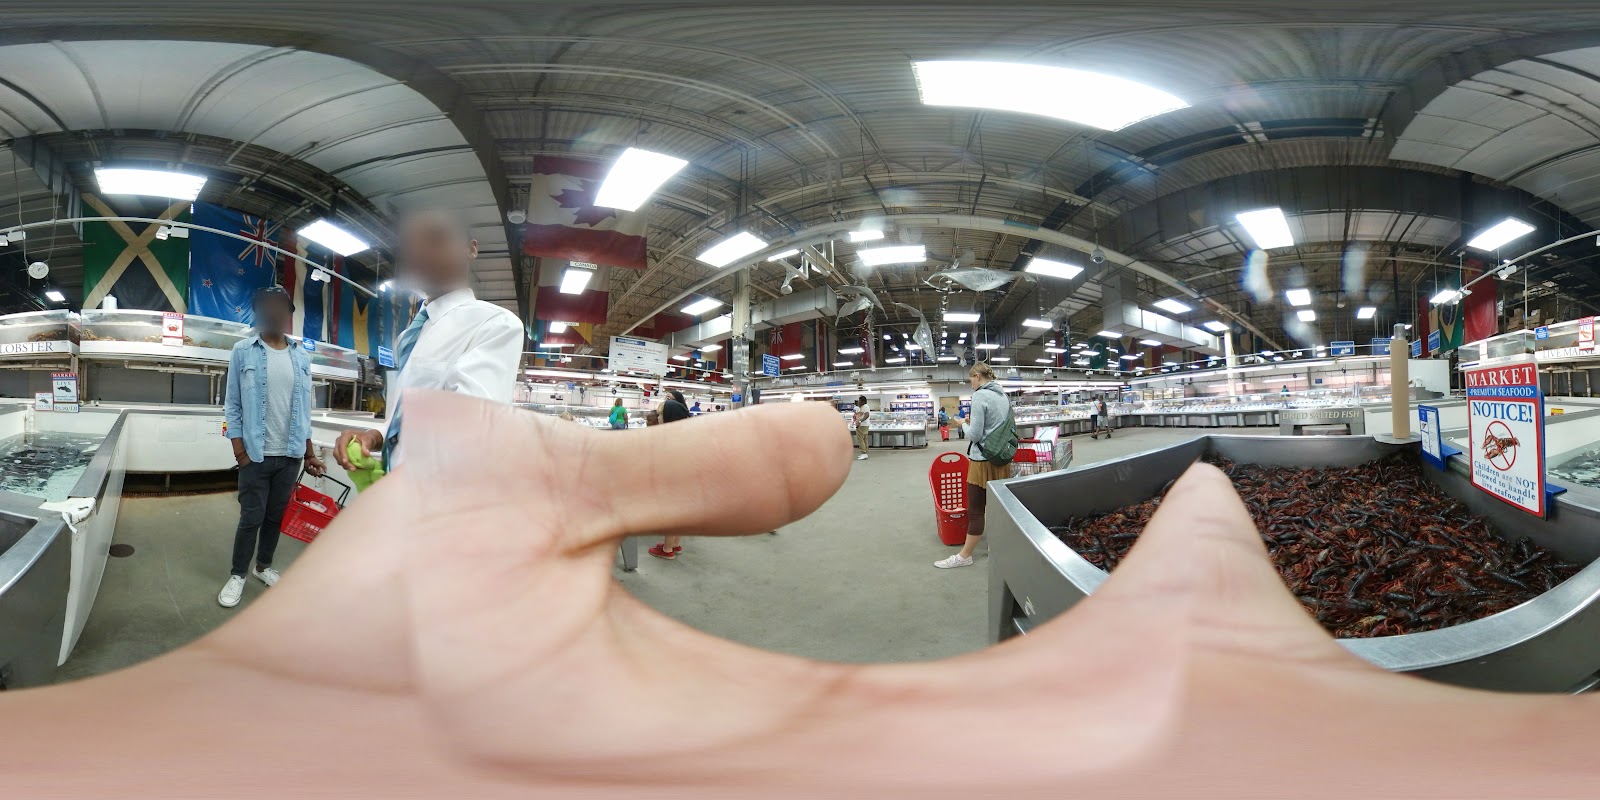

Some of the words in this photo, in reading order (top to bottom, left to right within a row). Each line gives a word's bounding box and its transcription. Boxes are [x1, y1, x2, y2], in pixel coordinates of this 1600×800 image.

[0, 342, 54, 354] LOBSTER
[1543, 350, 1562, 359] LIVE
[1467, 366, 1533, 387] MARKET
[1471, 387, 1497, 396] PREMIUM
[1498, 387, 1532, 397] SEAFOOD
[1282, 412, 1308, 420] DRIED
[1309, 411, 1340, 419] SALTED
[1341, 410, 1360, 418] FISH
[1472, 401, 1533, 423] NOTICE!
[1474, 460, 1500, 478] Children
[1501, 473, 1513, 482] are
[1515, 476, 1536, 491] NOT
[1475, 469, 1497, 484] allowed
[1498, 480, 1506, 488] to
[1508, 482, 1536, 501] handle
[1481, 478, 1493, 490] live
[1494, 486, 1524, 505] seafood!
